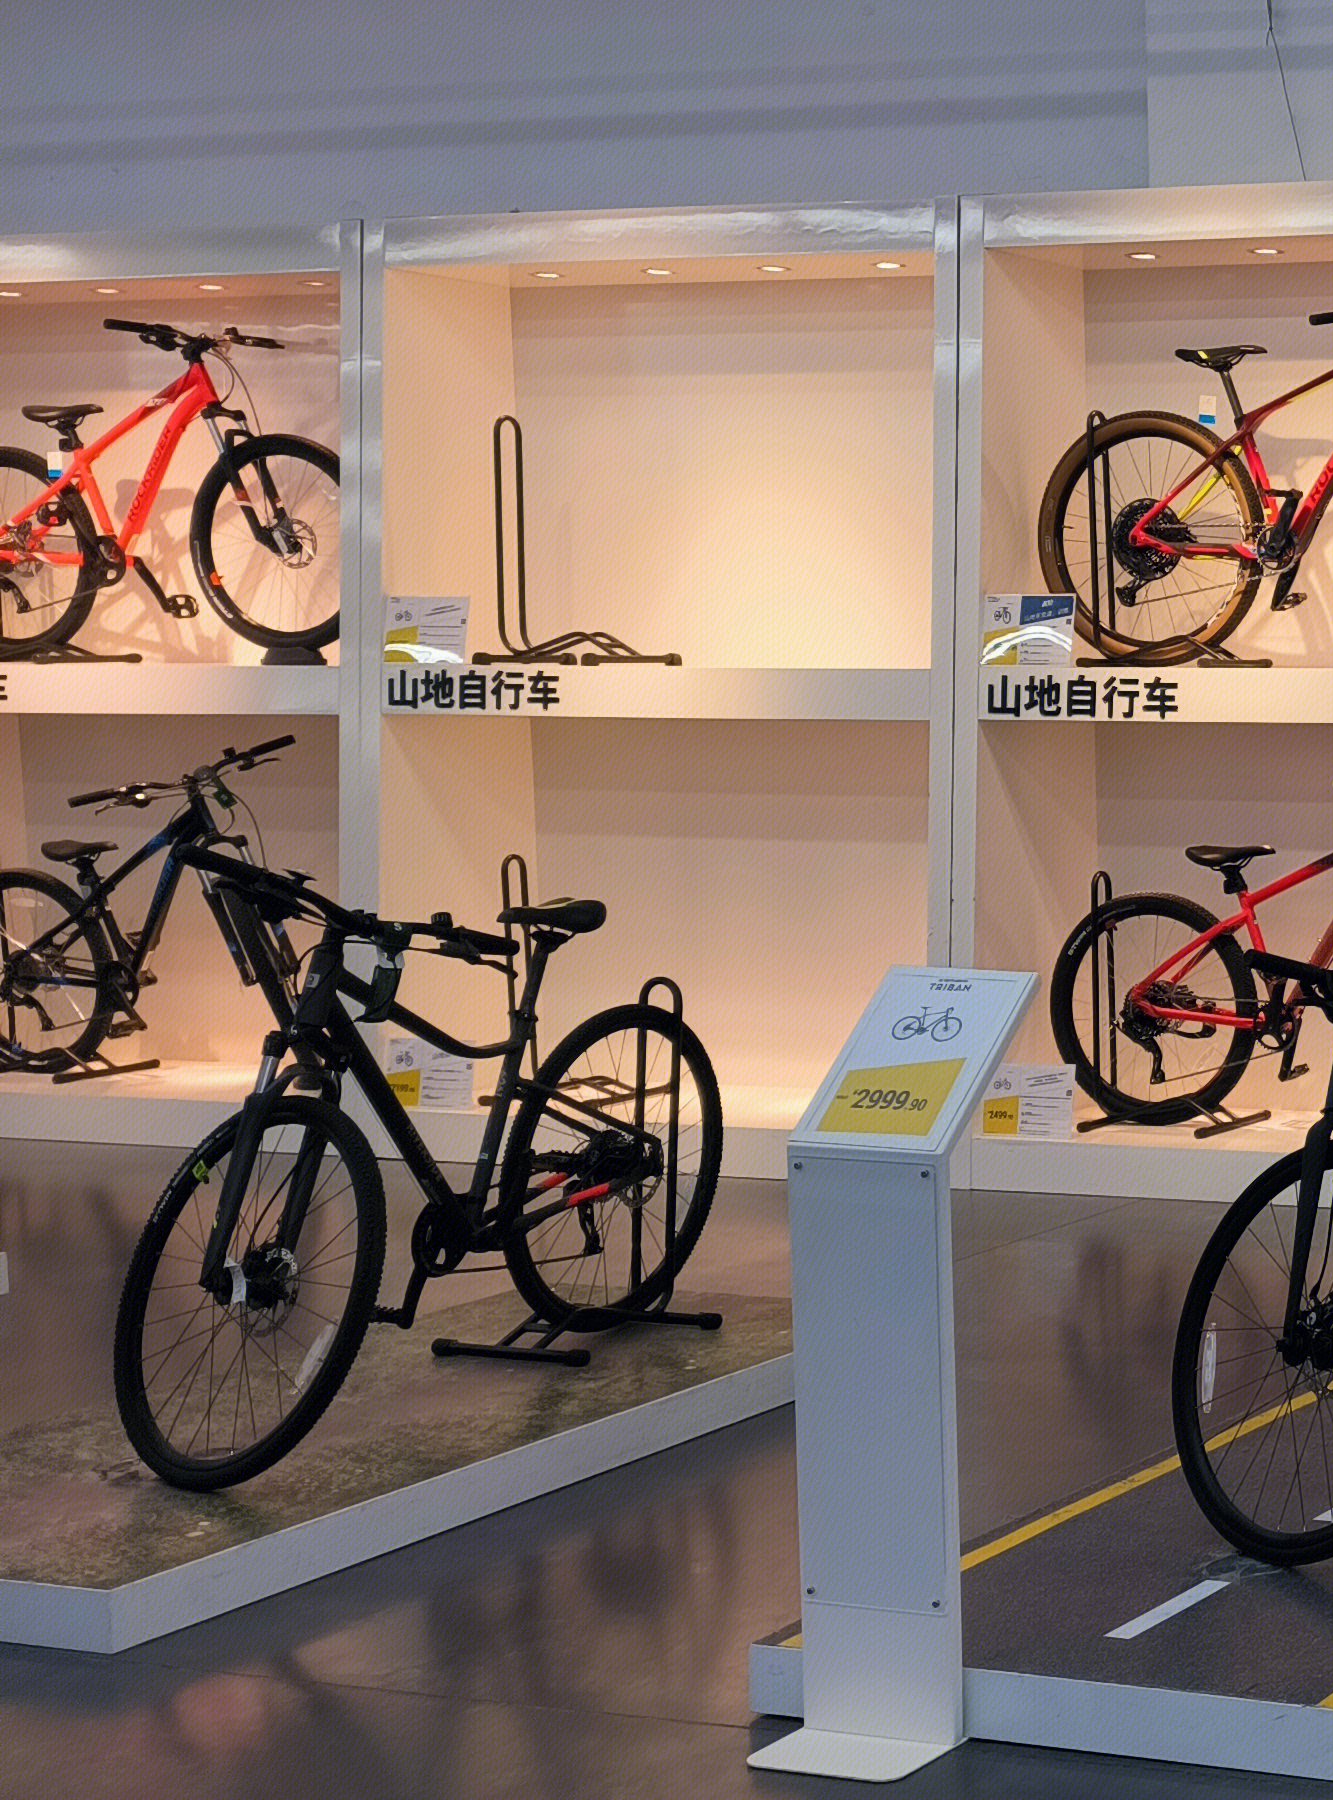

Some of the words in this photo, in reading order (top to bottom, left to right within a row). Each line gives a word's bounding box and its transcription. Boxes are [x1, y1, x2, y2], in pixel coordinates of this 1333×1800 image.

[388, 669, 560, 711] 山地自行车
[987, 674, 1179, 720] 山地自行车
[929, 982, 973, 992] TRIBAN
